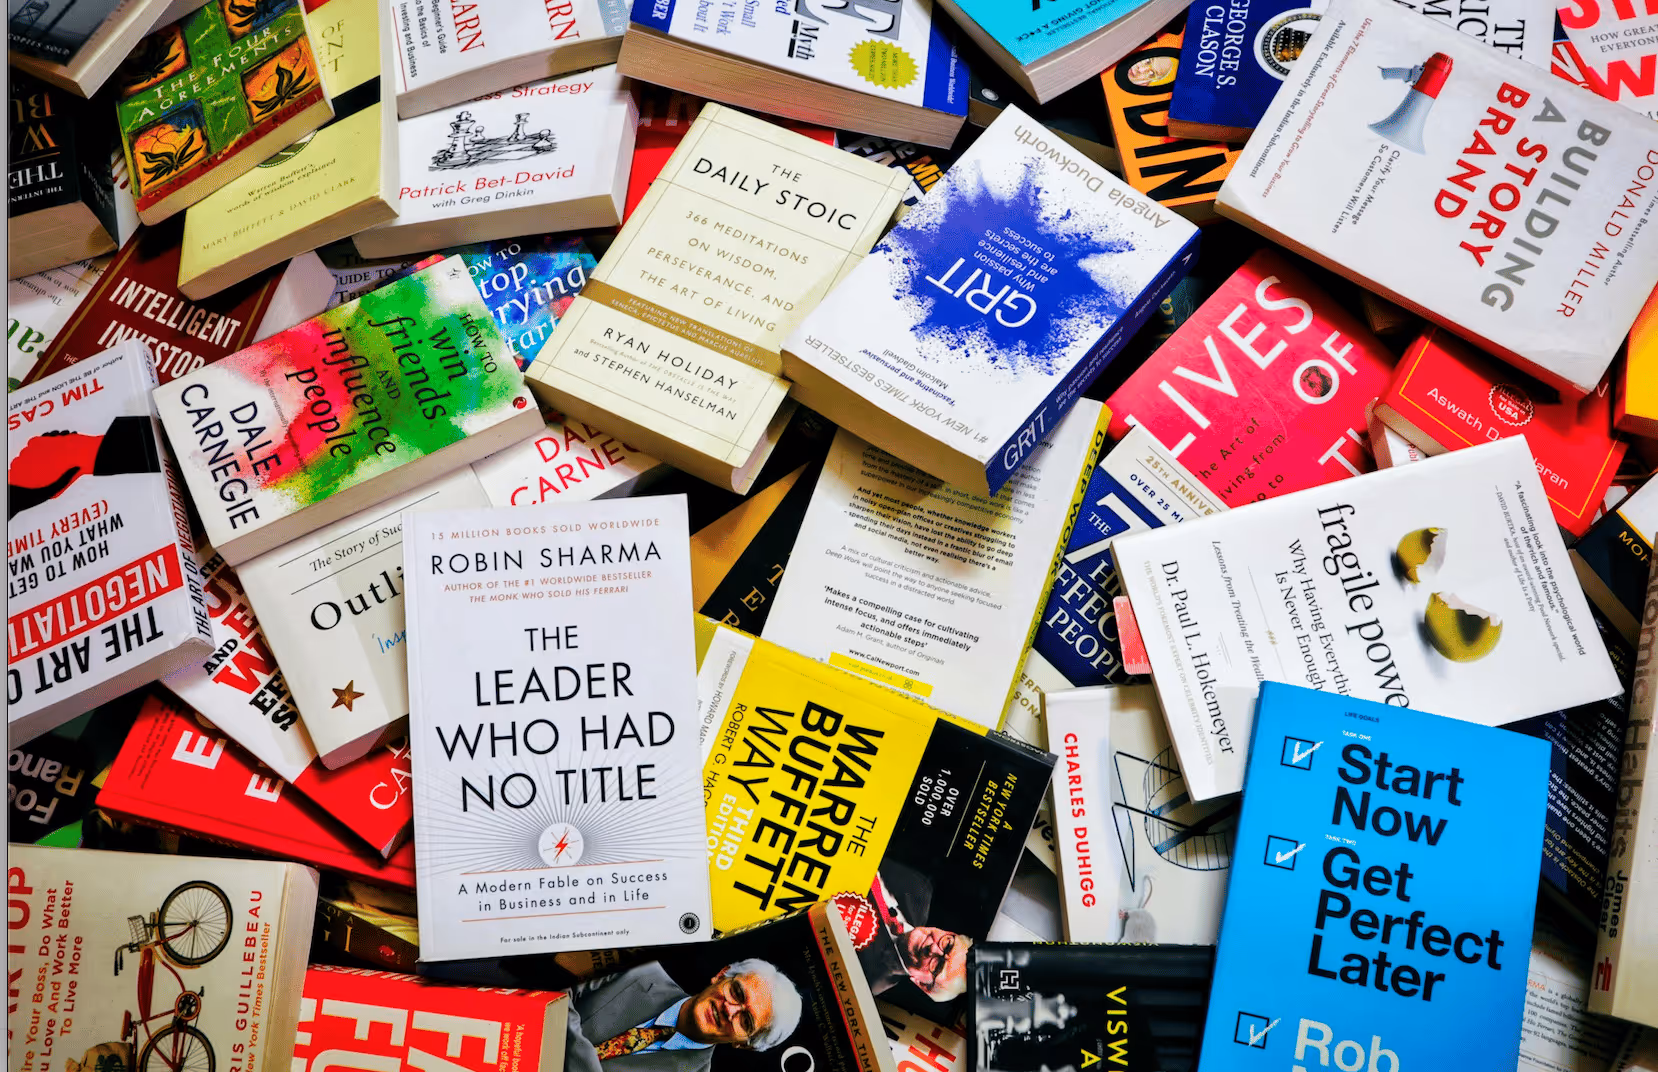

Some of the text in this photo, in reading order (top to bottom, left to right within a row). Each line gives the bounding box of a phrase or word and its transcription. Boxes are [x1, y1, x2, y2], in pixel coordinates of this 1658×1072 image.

[154, 27, 272, 99] THE FOUR
[401, 2, 418, 78] Investing and Business
[437, 33, 448, 54] Guide
[795, 21, 820, 61] Myth
[1195, 5, 1225, 78] CLASON
[138, 26, 292, 121] AGREEMENTS
[511, 80, 594, 98] Strategy
[1532, 97, 1567, 123] A
[399, 164, 575, 200] Patrick Bet-David
[771, 163, 803, 183] THE
[1013, 123, 1171, 229] Angela Duckworth
[1434, 81, 1531, 220] BRAND
[432, 188, 534, 209] with Greg Dinkin
[692, 157, 857, 231] DAILY STOIC
[1331, 144, 1389, 234] So Customers Will Listen
[1352, 150, 1400, 225] Clarify Your Message
[1460, 136, 1548, 267] STORY
[1481, 119, 1612, 312] BUILDING
[685, 210, 809, 266] 366 MEDITATIONS
[688, 238, 778, 281] ON WISDOM,
[978, 240, 1049, 284] and resilience
[984, 229, 1058, 276] are the secrets
[1003, 227, 1056, 262] to success
[1557, 150, 1658, 318] DONALD MILLER
[640, 269, 777, 333] THE ART OF LIVING
[646, 246, 796, 312] PERSEVERANCE, AND
[925, 257, 1037, 328] GRIT
[974, 251, 1036, 292] Why passion
[109, 276, 241, 348] INTELLIGENT
[459, 312, 498, 374] HOW TO
[368, 315, 451, 421] friends
[375, 369, 401, 400] AND
[428, 326, 469, 381] win
[574, 347, 738, 421] and STEPHEN HANSELMAN
[603, 327, 739, 390] RYAN HOLIDAY
[882, 348, 949, 391] Malcolm Gladwell
[1124, 275, 1314, 458] LIVES
[1292, 330, 1358, 405] OF
[61, 378, 104, 407] TIM
[284, 366, 352, 459] people
[322, 326, 397, 456] influence
[804, 335, 989, 444] #1 NEW YORK TIMES BESTSELLER
[1427, 387, 1483, 431] Aswath
[1498, 402, 1518, 420] USA
[179, 383, 261, 530] CARNEGIE
[228, 401, 282, 476] DALE
[1002, 406, 1048, 472] GRIT
[1219, 416, 1260, 460] Art of
[1130, 473, 1170, 512] OVER 25
[41, 513, 125, 565] WHAT YOU
[309, 531, 382, 574] The Story of
[430, 518, 660, 540] 15 MILLION BOOKS SOLD WORLDWIDE
[431, 541, 662, 575] ROBIN SHARMA
[1316, 501, 1381, 614] fragile
[46, 540, 110, 583] HOW TO
[1288, 538, 1325, 632] Why Having
[1517, 490, 1586, 656] fascinating look into the psychological world
[34, 605, 165, 695] THE ART
[524, 625, 579, 652] THE
[859, 597, 903, 618] compelling
[904, 613, 923, 624] case
[924, 618, 936, 628] for
[937, 622, 980, 643] cultivating
[1275, 570, 1327, 691] Is Never Enough
[202, 637, 240, 677] AND
[475, 662, 634, 707] LEADER
[848, 648, 920, 677] www.CalNewport.com
[1161, 560, 1235, 755] Dr. Paul L. Hokemeyer
[435, 711, 675, 762] WHO HAD
[727, 705, 795, 805] WAY
[462, 764, 657, 812] NO TITLE
[733, 700, 844, 912] BUFFETT
[915, 776, 933, 805] SOLD
[922, 769, 951, 825] 1,000,000
[940, 788, 959, 817] OVER
[1336, 743, 1465, 807] Start
[715, 805, 754, 871] THIRD
[774, 723, 885, 914] WARREN
[846, 814, 878, 858] THE
[964, 780, 999, 850] BESTSELLER
[973, 773, 1018, 869] NEW YORK TIMES
[1003, 821, 1013, 830] A
[1064, 732, 1096, 909] CHARLES DUHIGG
[1331, 786, 1449, 846] Now
[458, 871, 668, 895] A Modern Fable on Success
[478, 889, 650, 912] in Business and in Life
[1322, 845, 1414, 903] Get
[1600, 876, 1616, 934] Clear
[1608, 869, 1629, 939] James
[236, 890, 263, 1031] GUILLEBEAU
[1314, 889, 1504, 972] Perfect
[25, 888, 57, 1045] Your Boss, Do What
[248, 922, 271, 1048] York Times Bestseller
[1307, 935, 1445, 1003] Later
[1293, 1017, 1400, 1072] Rob
